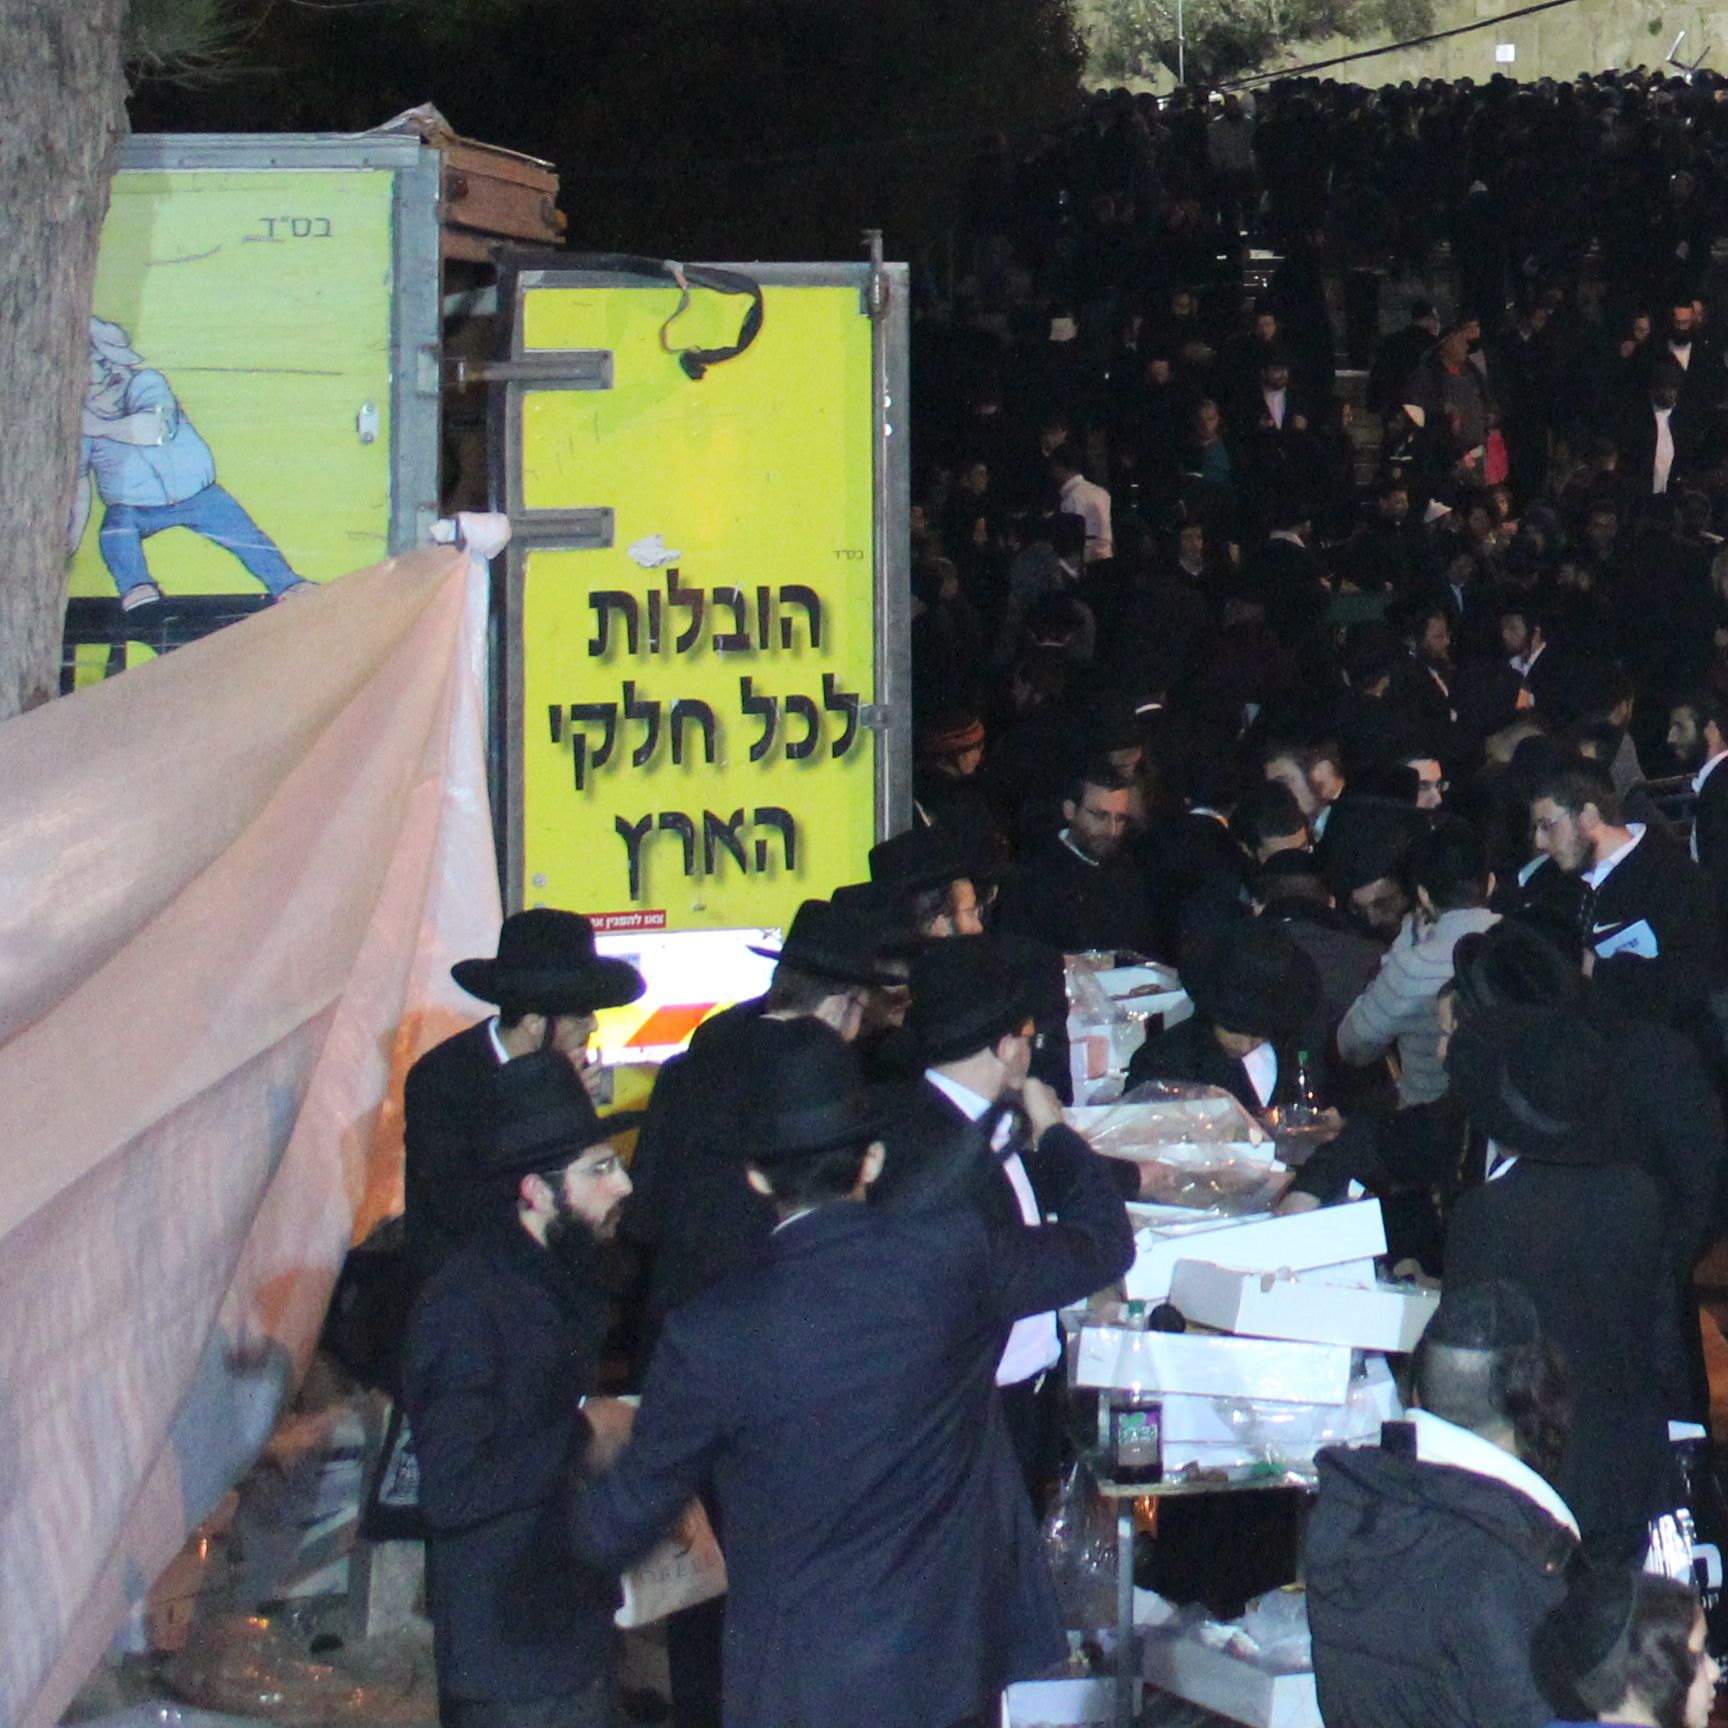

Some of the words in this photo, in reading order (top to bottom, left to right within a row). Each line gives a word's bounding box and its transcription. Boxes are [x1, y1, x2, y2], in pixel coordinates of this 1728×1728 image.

[587, 568, 822, 657] הובלות
[549, 680, 716, 790] חלקי
[739, 673, 859, 762] לכל
[614, 807, 796, 901] הארץ
